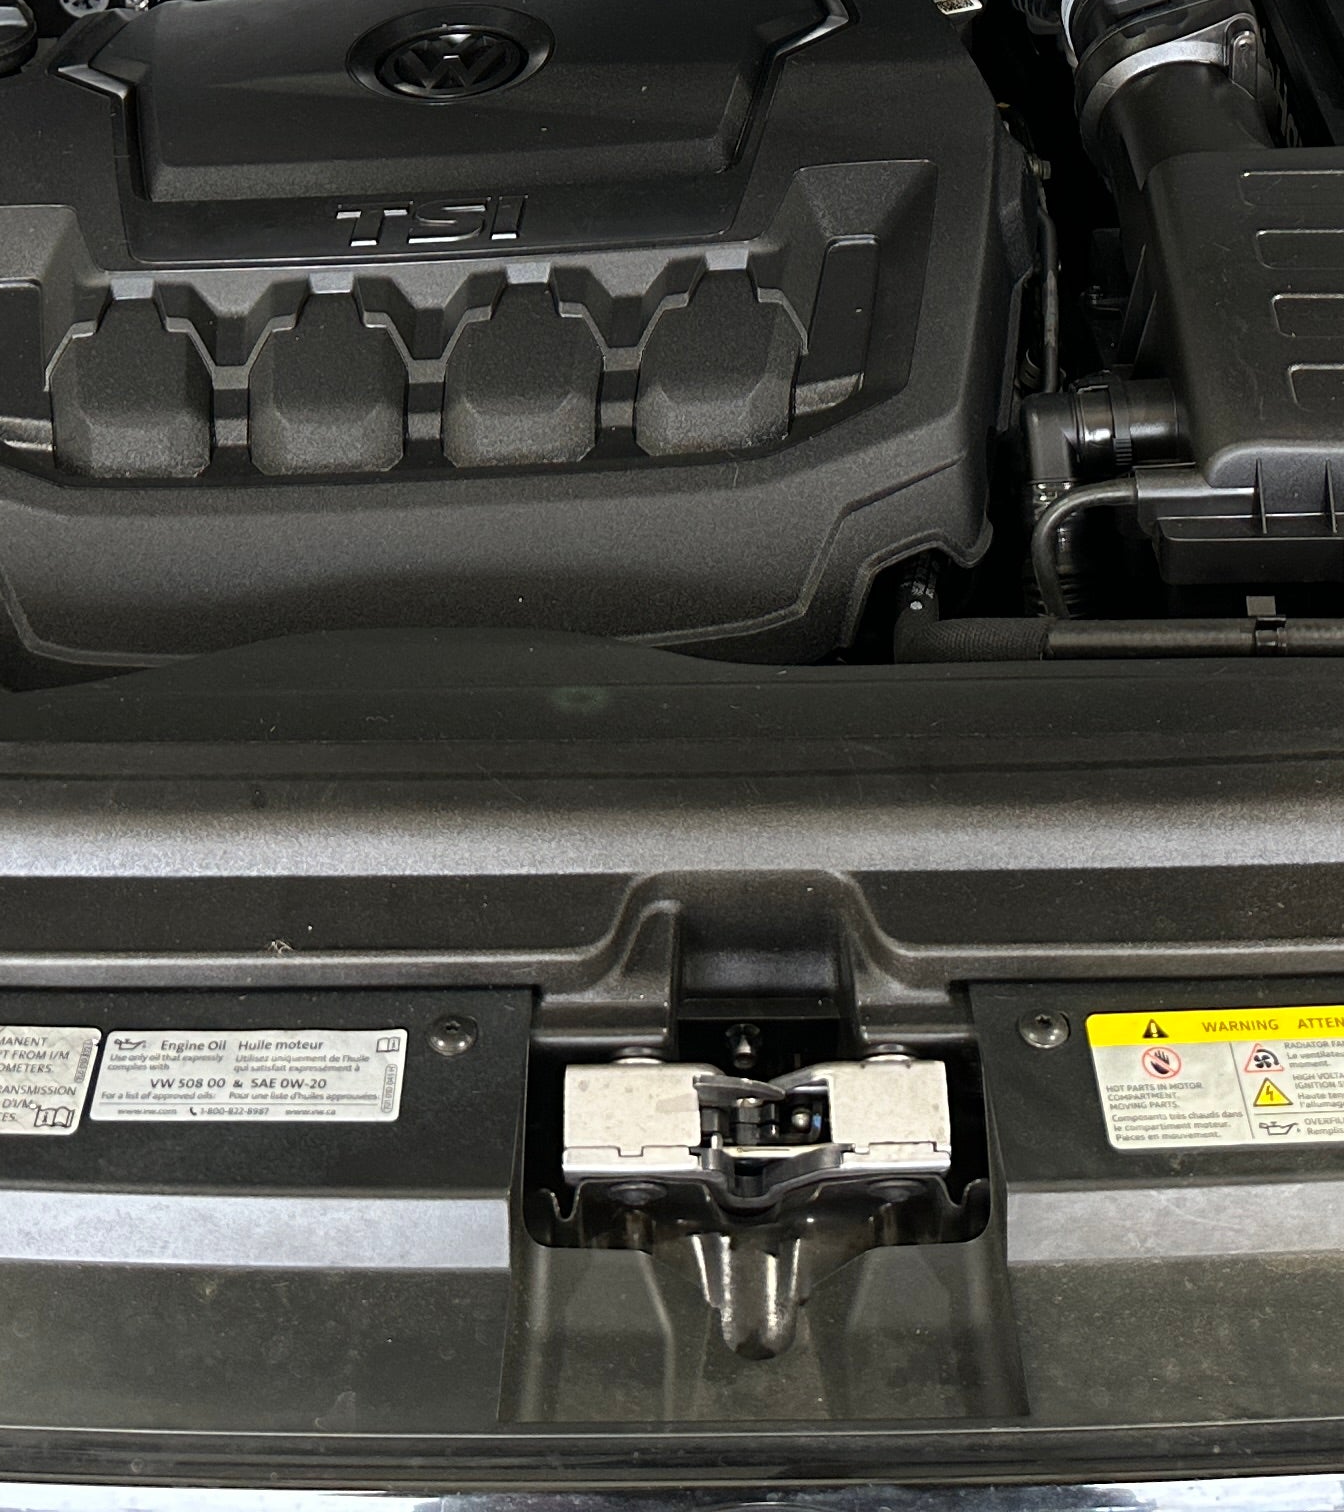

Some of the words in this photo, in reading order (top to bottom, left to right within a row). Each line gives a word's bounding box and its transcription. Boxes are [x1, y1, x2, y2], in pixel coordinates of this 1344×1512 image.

[335, 194, 529, 247] TSI
[1203, 1018, 1280, 1034] WARNING
[161, 1040, 204, 1052] Engine
[208, 1040, 226, 1050] Oil
[238, 1040, 272, 1051] Huile
[275, 1041, 324, 1050] moteur
[12, 1050, 46, 1060] FROM
[49, 1051, 70, 1060] I/M
[128, 1054, 148, 1063] only
[149, 1053, 161, 1061] oil
[354, 1064, 360, 1072] à
[150, 1078, 175, 1088] VW
[178, 1078, 203, 1088] 508
[207, 1078, 226, 1088] 00
[232, 1079, 243, 1088] &
[250, 1078, 276, 1089] SAE
[280, 1078, 327, 1089] 0W-20
[1127, 1083, 1155, 1091] PARTS
[1169, 1082, 1202, 1090] MOTOR
[229, 1092, 249, 1100] Pour
[1110, 1101, 1147, 1110] MOVING
